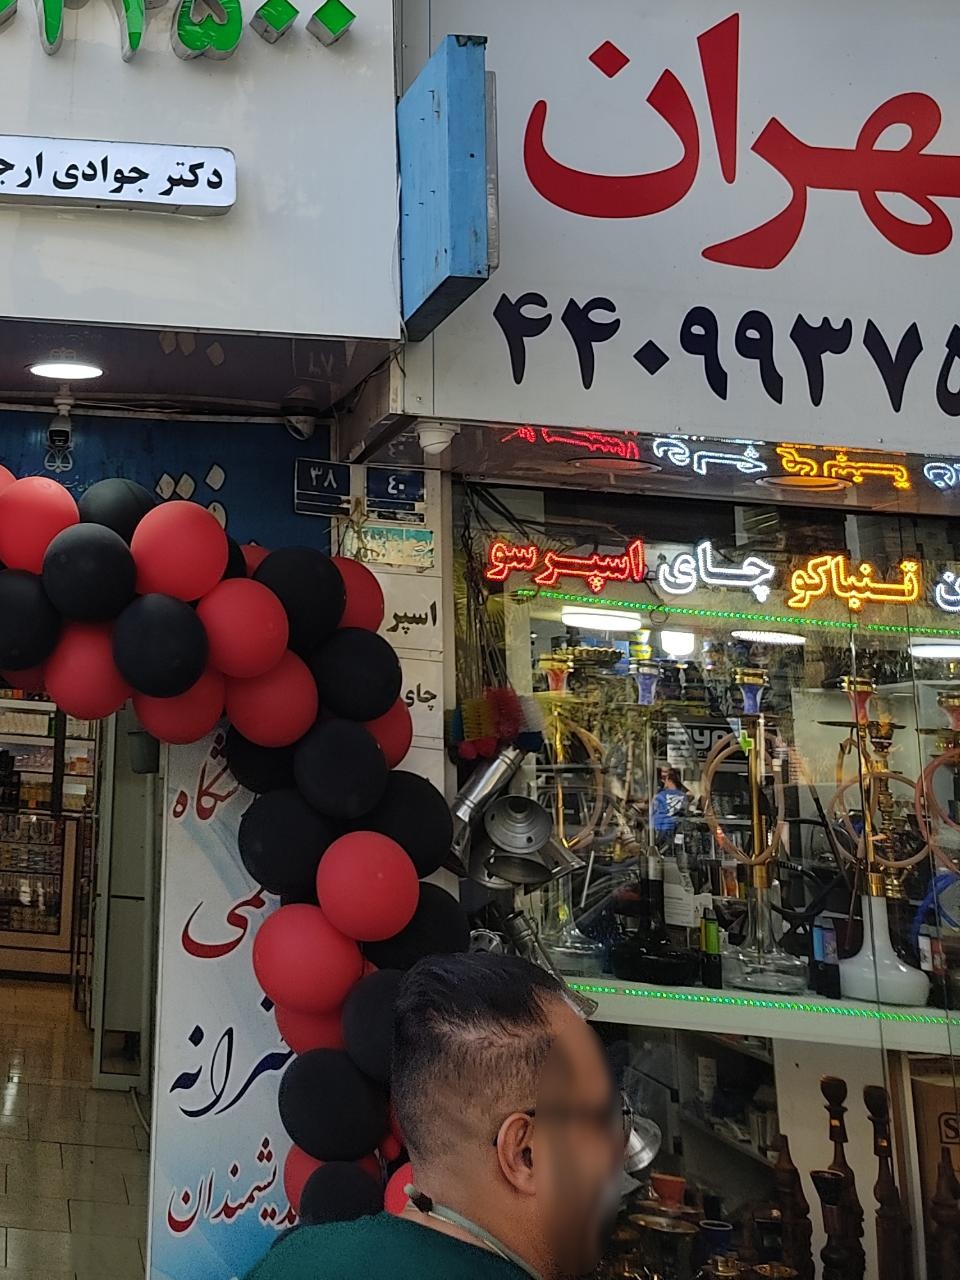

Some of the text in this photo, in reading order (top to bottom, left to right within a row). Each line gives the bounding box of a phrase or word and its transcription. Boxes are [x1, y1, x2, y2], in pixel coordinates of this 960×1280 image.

[523, 12, 960, 270] هران
[52, 155, 150, 195] جوادی
[158, 161, 223, 196] دکتر
[310, 467, 337, 488] ۳۸
[657, 539, 775, 603] چای
[786, 554, 922, 611] تنباکو
[405, 683, 437, 711] چای
